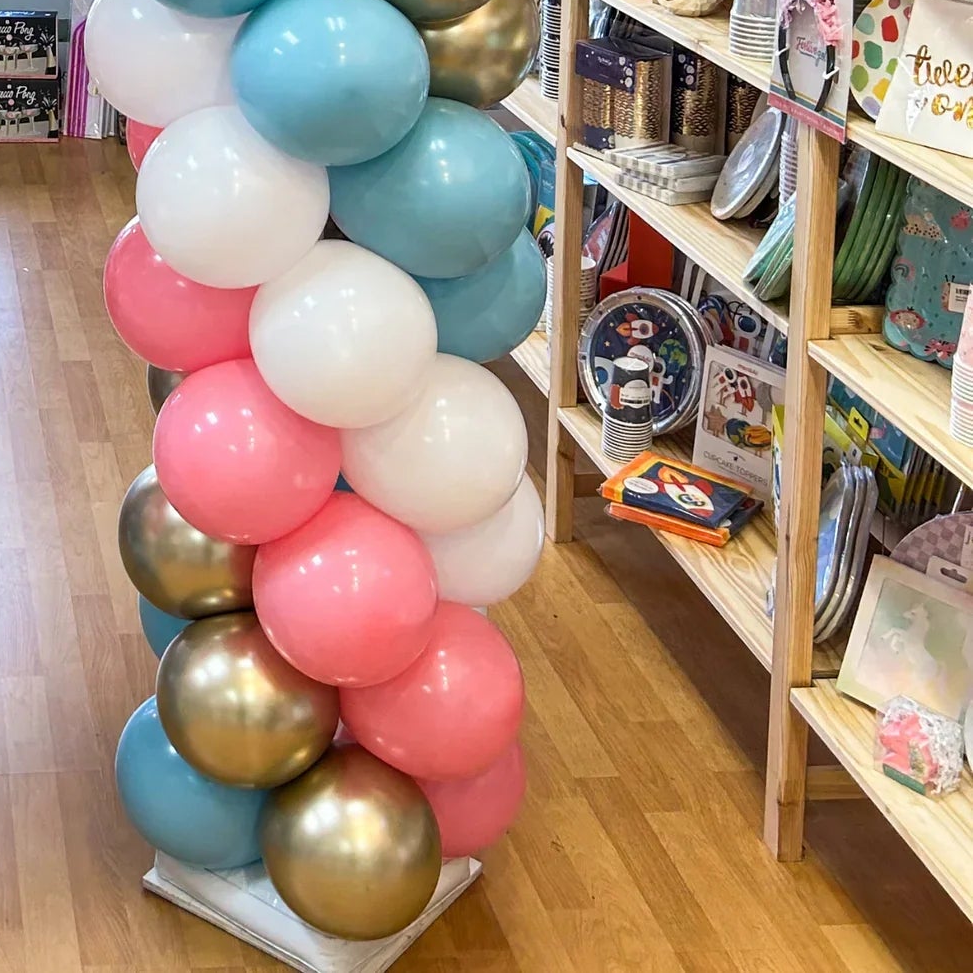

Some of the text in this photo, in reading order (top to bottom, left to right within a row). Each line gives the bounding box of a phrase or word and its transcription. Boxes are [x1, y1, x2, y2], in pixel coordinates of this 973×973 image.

[13, 21, 35, 41] Pong
[15, 85, 36, 105] Pong
[703, 450, 735, 472] CUPCAKE
[735, 464, 769, 487] TOPPERS
